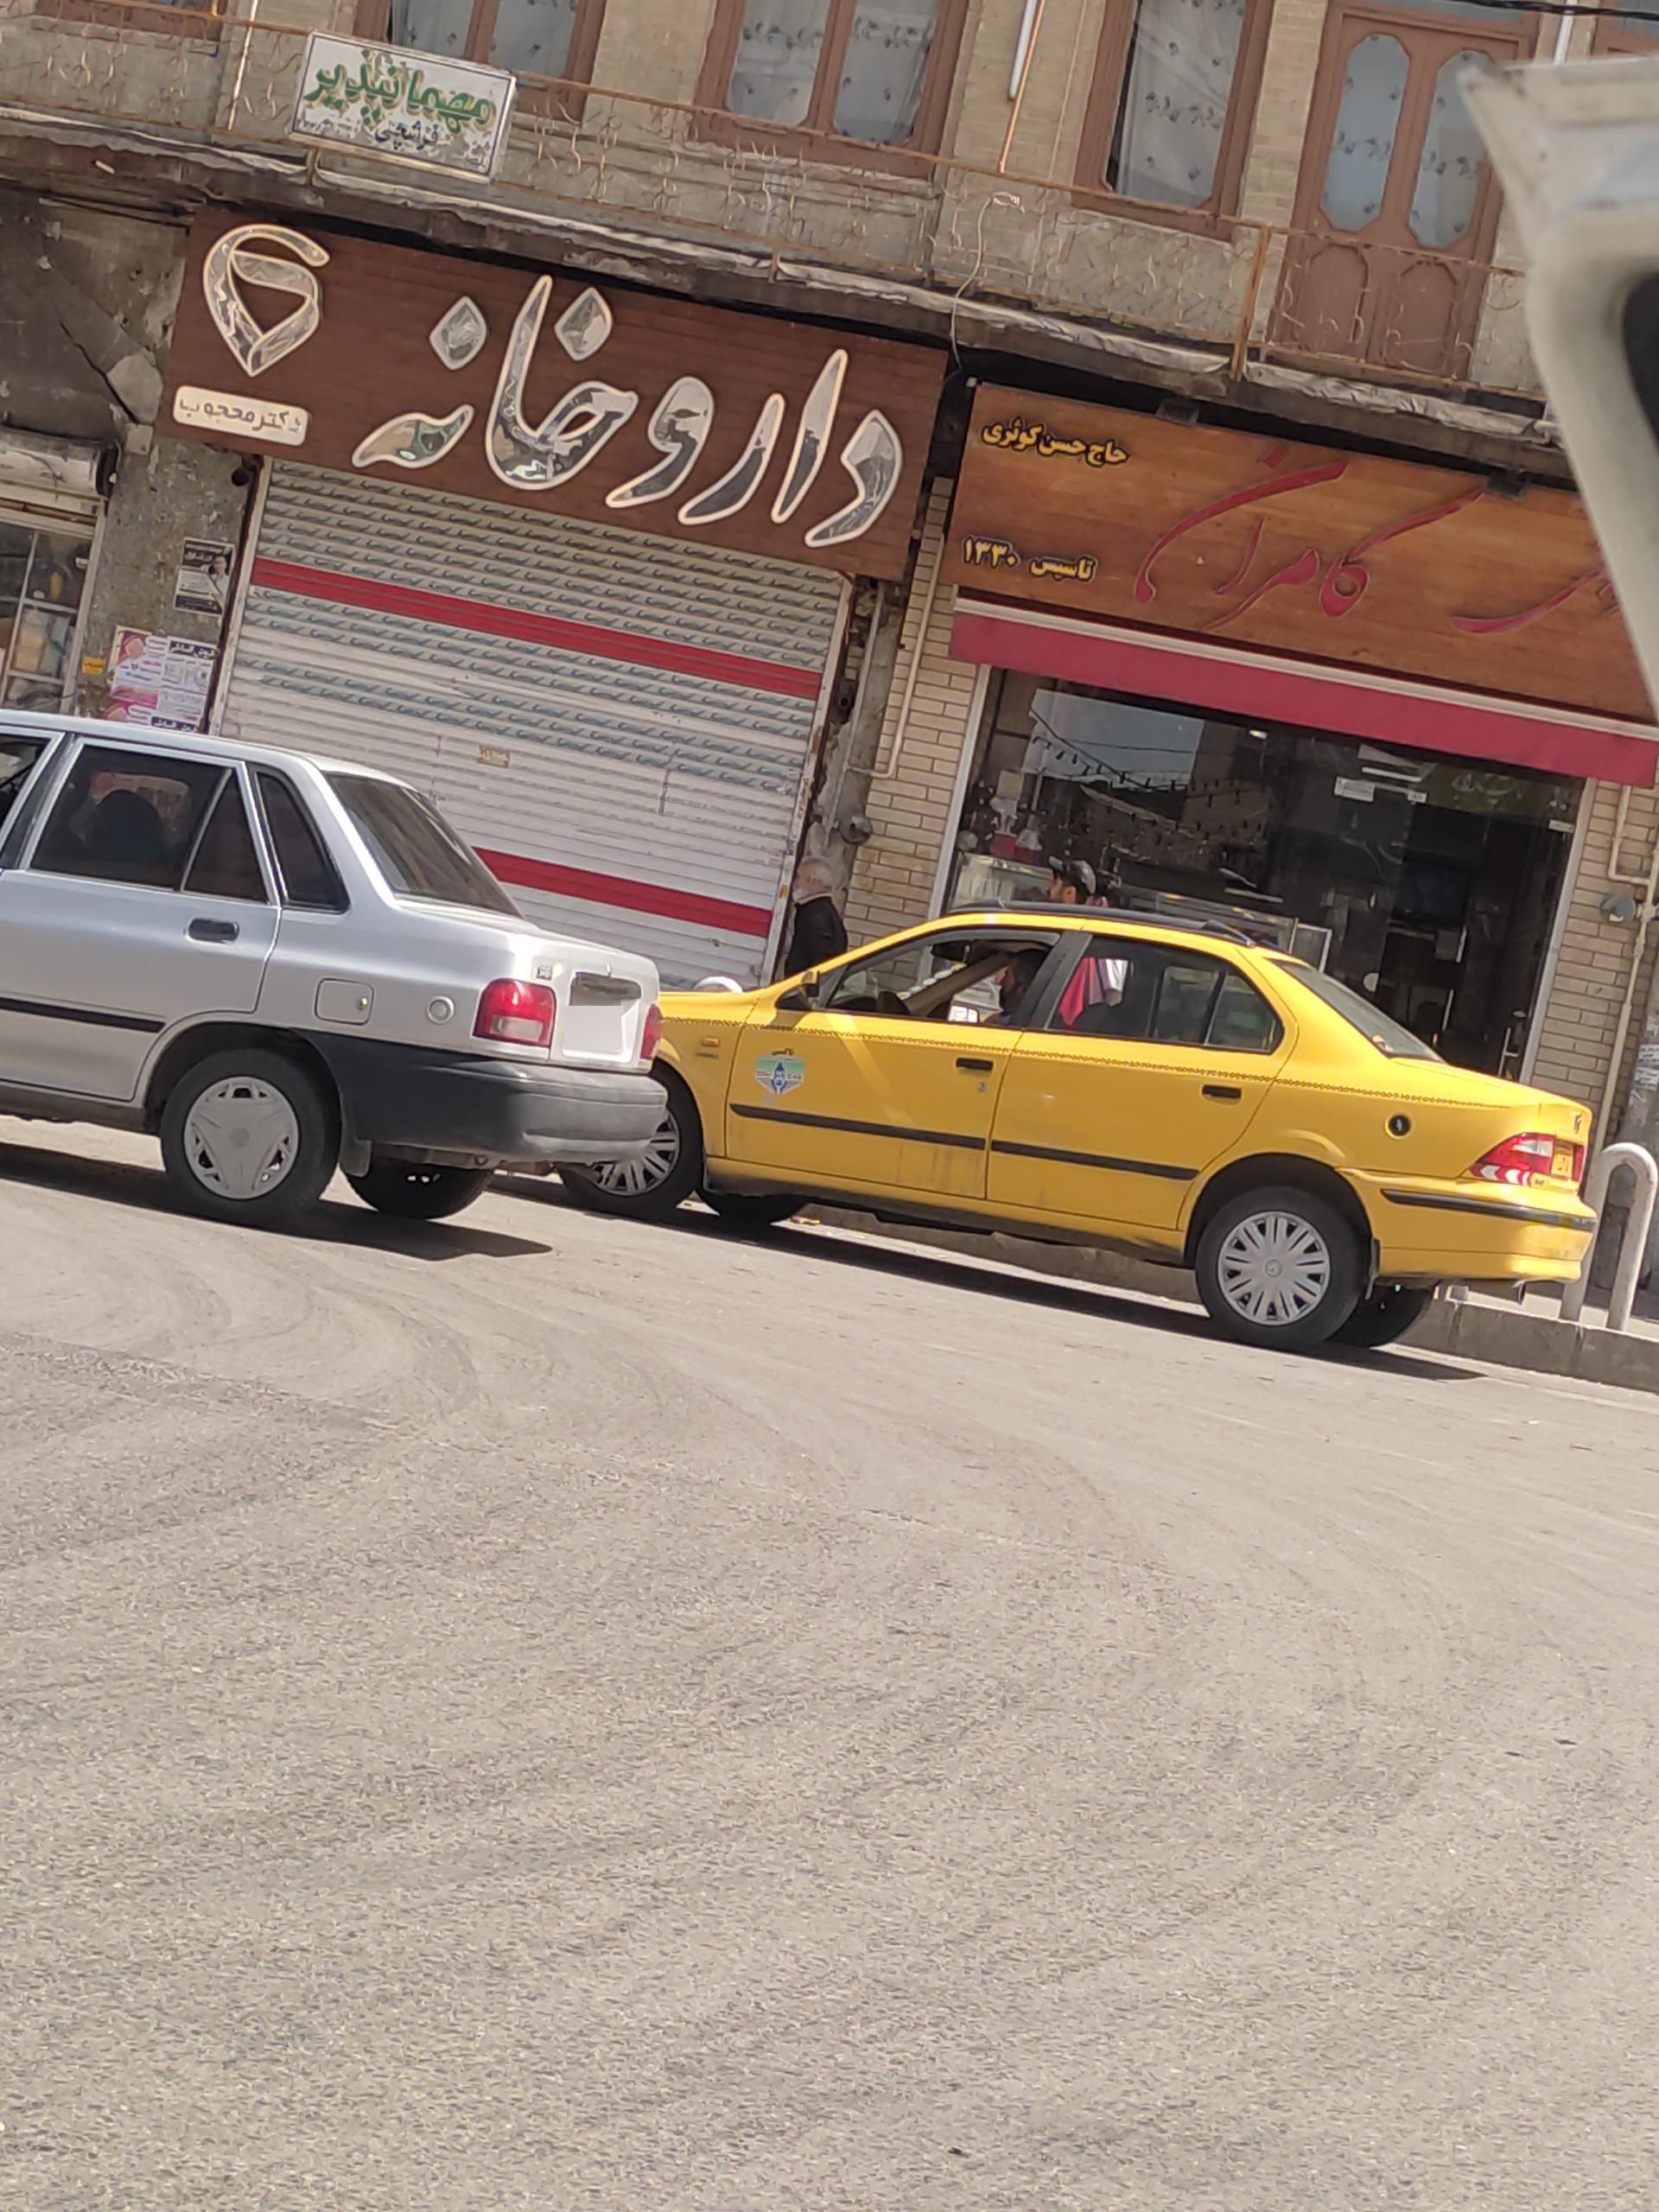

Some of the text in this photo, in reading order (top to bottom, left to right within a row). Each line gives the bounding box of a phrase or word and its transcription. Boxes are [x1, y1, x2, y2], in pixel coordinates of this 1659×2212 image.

[179, 398, 302, 433] دکتر محجوب
[352, 275, 903, 548] داروخانه
[1038, 433, 1087, 457] حسن
[1085, 439, 1130, 467] حاج
[963, 537, 1097, 582] تاسیس ۱۳۳۰
